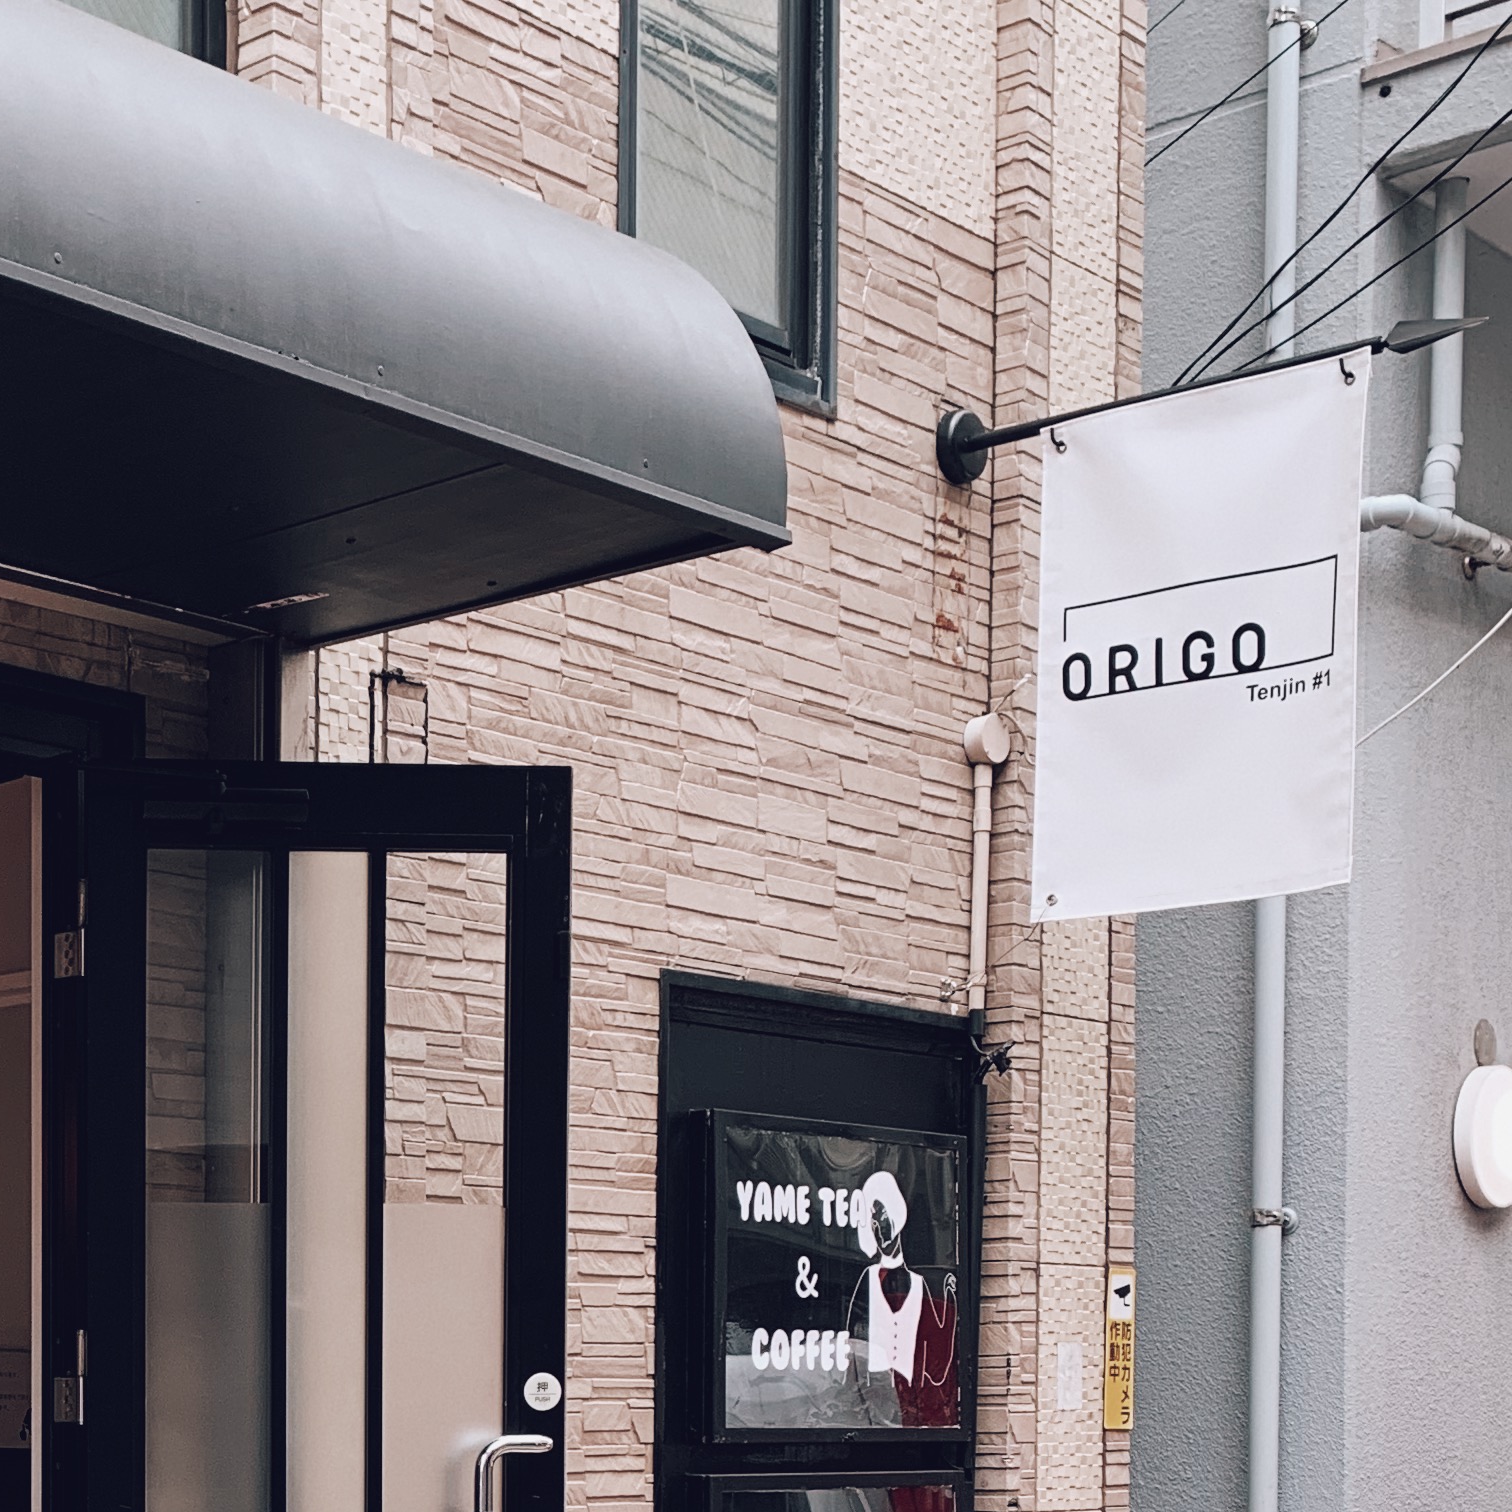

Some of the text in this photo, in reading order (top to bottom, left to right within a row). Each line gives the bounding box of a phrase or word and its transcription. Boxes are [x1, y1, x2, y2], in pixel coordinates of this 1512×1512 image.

[1062, 622, 1266, 702] ORIGO
[1246, 669, 1333, 703] Tenjin #1
[736, 1180, 867, 1229] YAME TEA
[795, 1255, 820, 1299] &
[751, 1327, 851, 1371] COFFEE
[1109, 1321, 1121, 1382] 作動中
[536, 1381, 548, 1392] 押
[1121, 1322, 1132, 1424] 防犯カメラ
